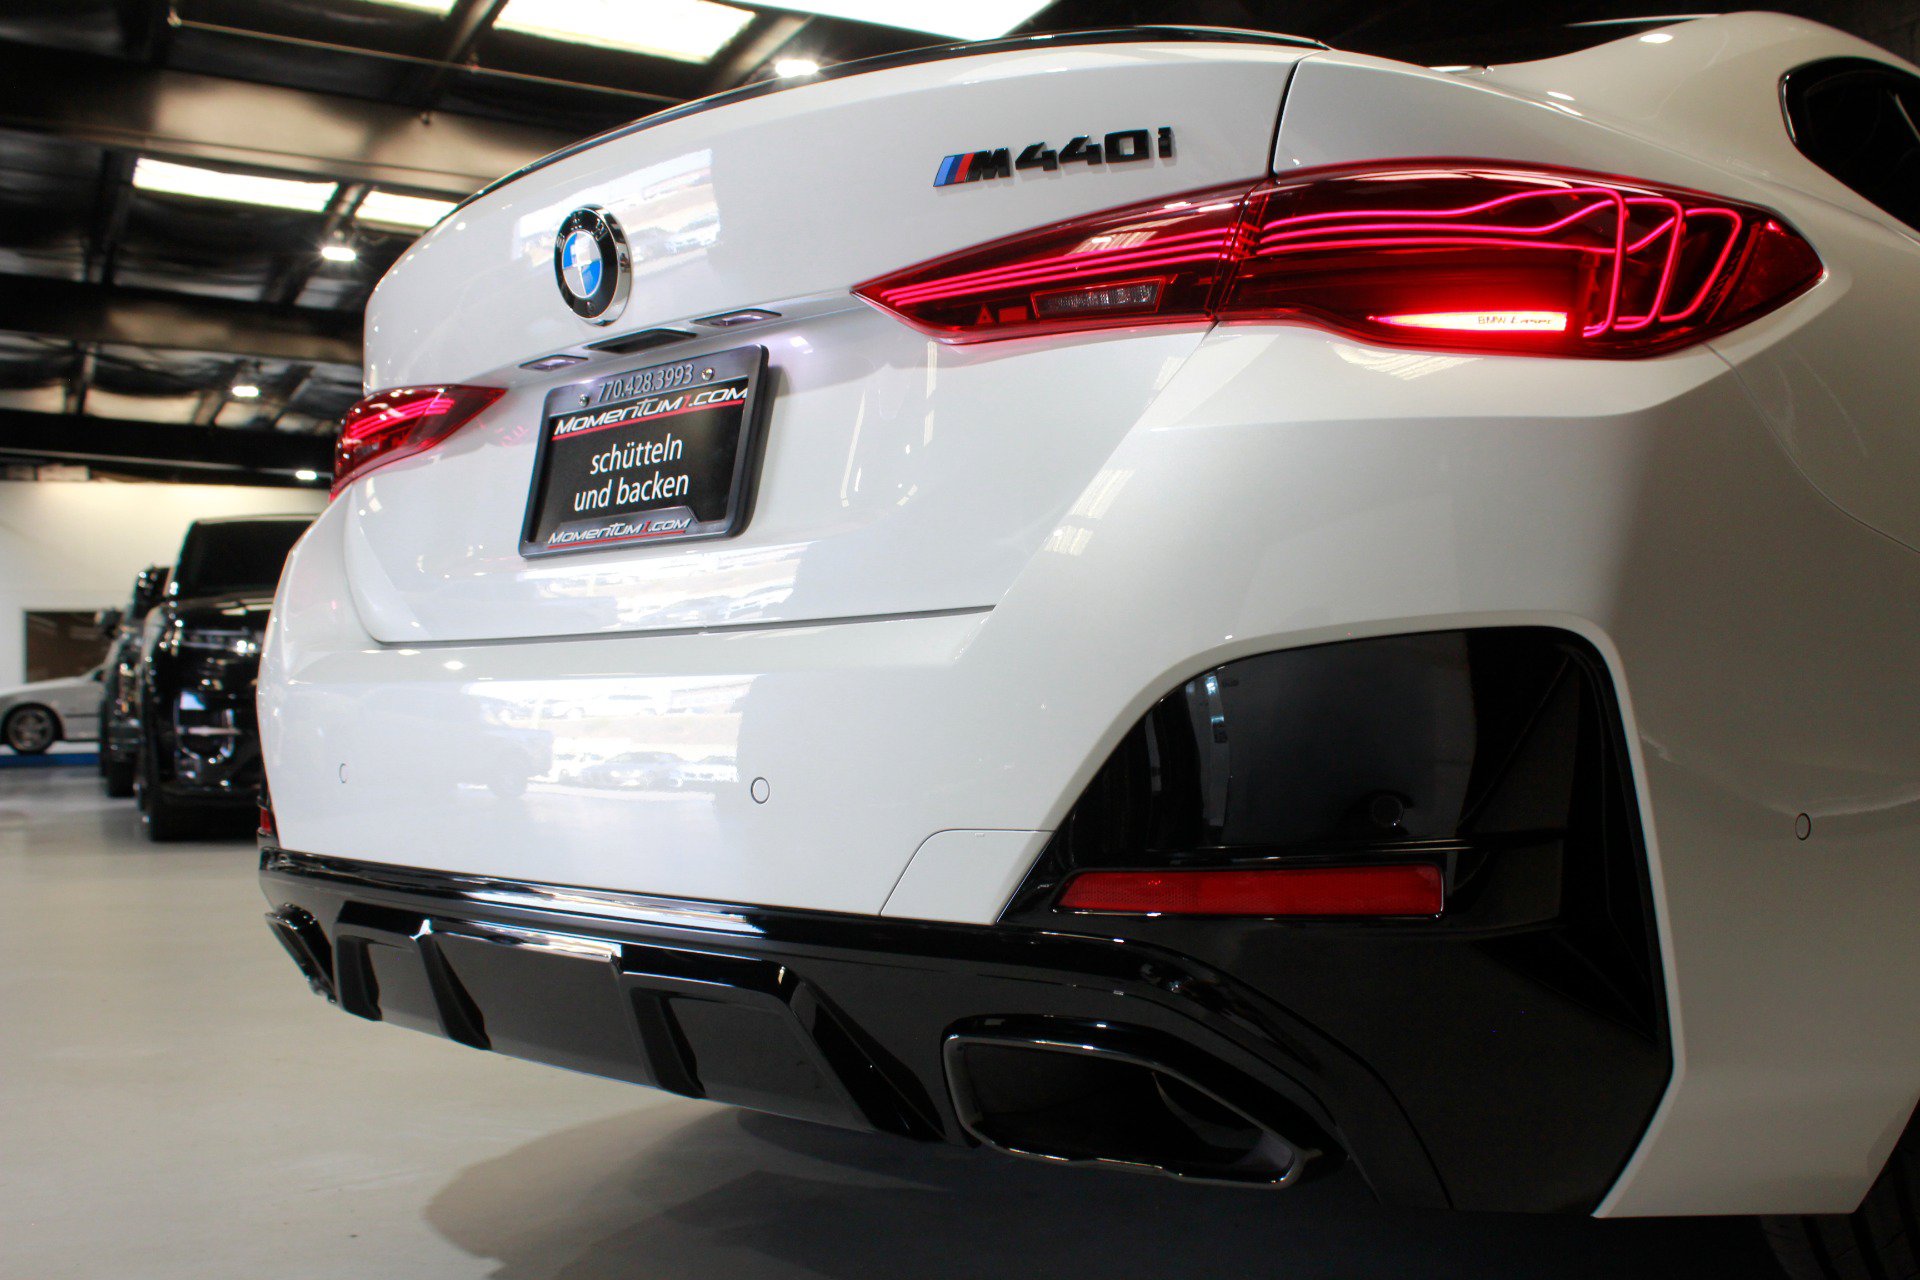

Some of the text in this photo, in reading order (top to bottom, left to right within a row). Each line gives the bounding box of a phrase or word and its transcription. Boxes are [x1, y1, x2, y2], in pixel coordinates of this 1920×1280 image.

[962, 126, 1173, 182] M440i
[598, 363, 694, 402] 770.428.3993
[590, 433, 683, 475] schütteln
[574, 471, 689, 512] und backen
